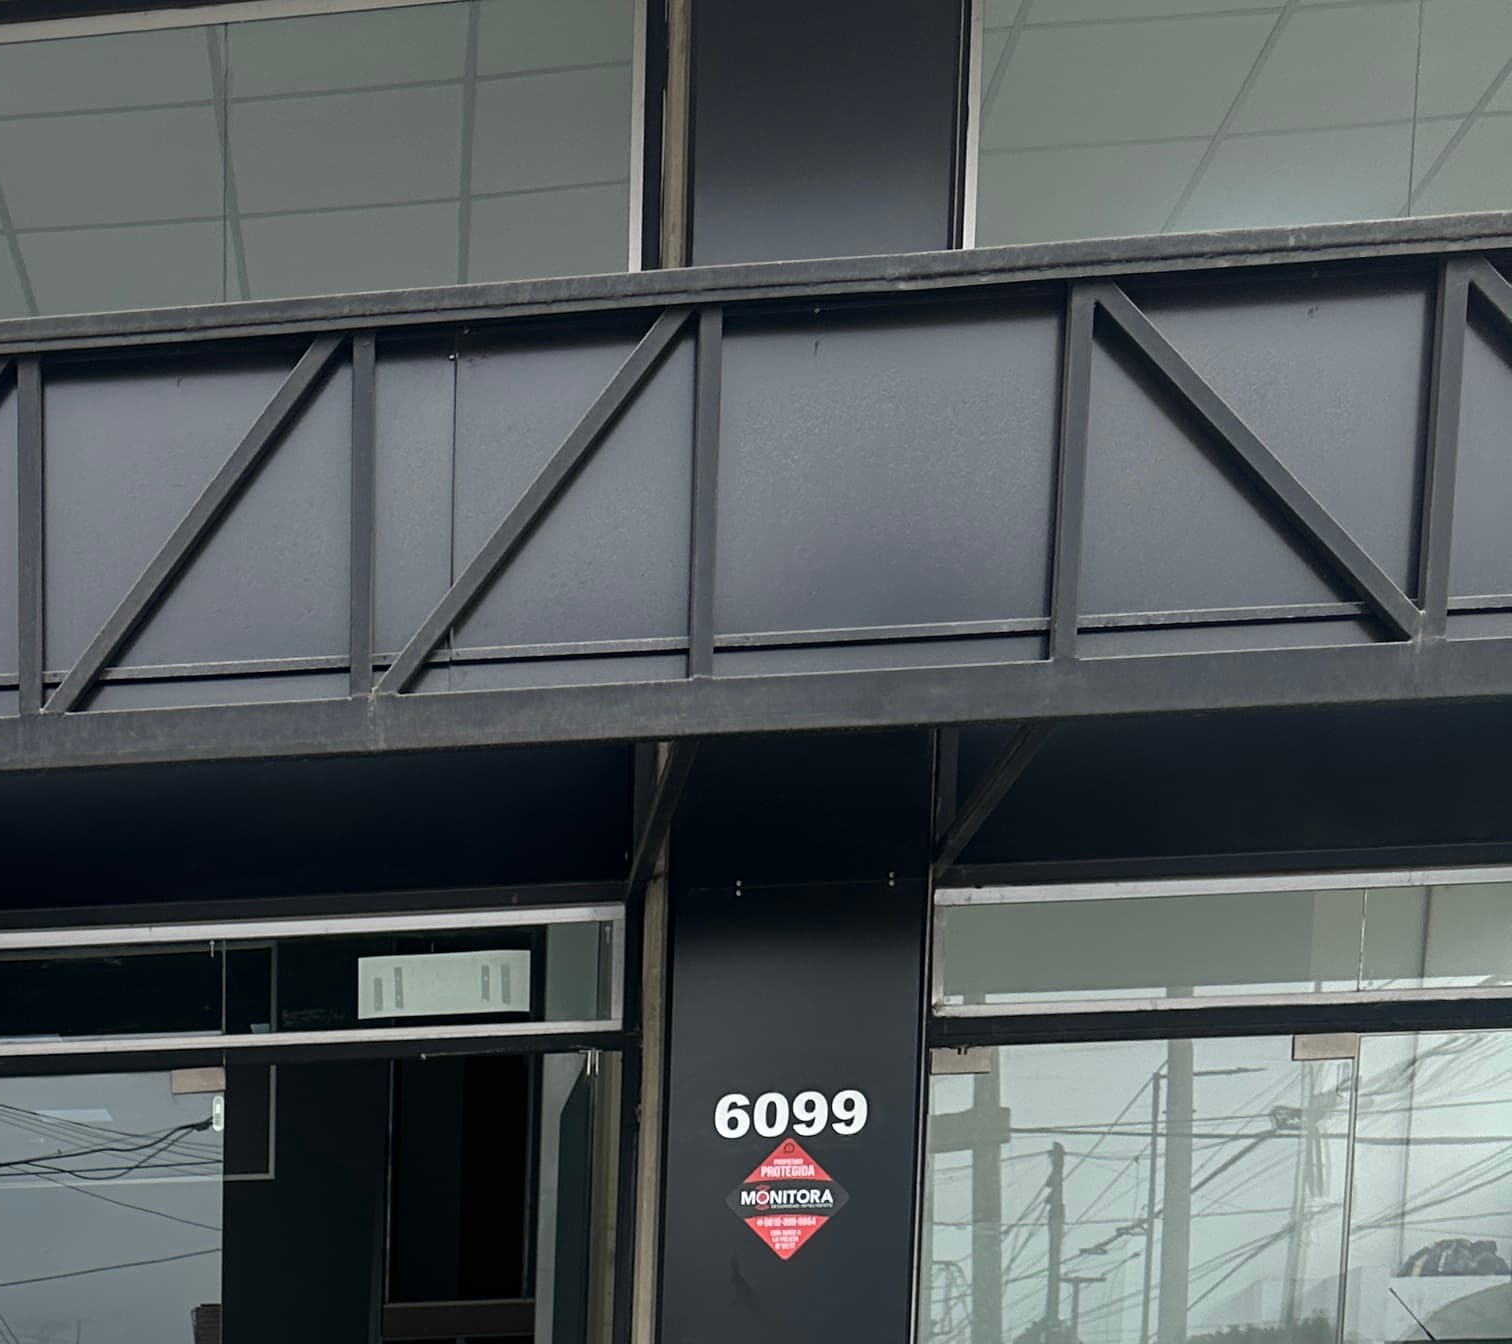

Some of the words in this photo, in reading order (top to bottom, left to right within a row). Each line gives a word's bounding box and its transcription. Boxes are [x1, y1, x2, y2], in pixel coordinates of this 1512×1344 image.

[714, 1089, 868, 1139] 6099
[760, 1165, 815, 1178] PROTEGIDA
[741, 1189, 833, 1205] MONITORA
